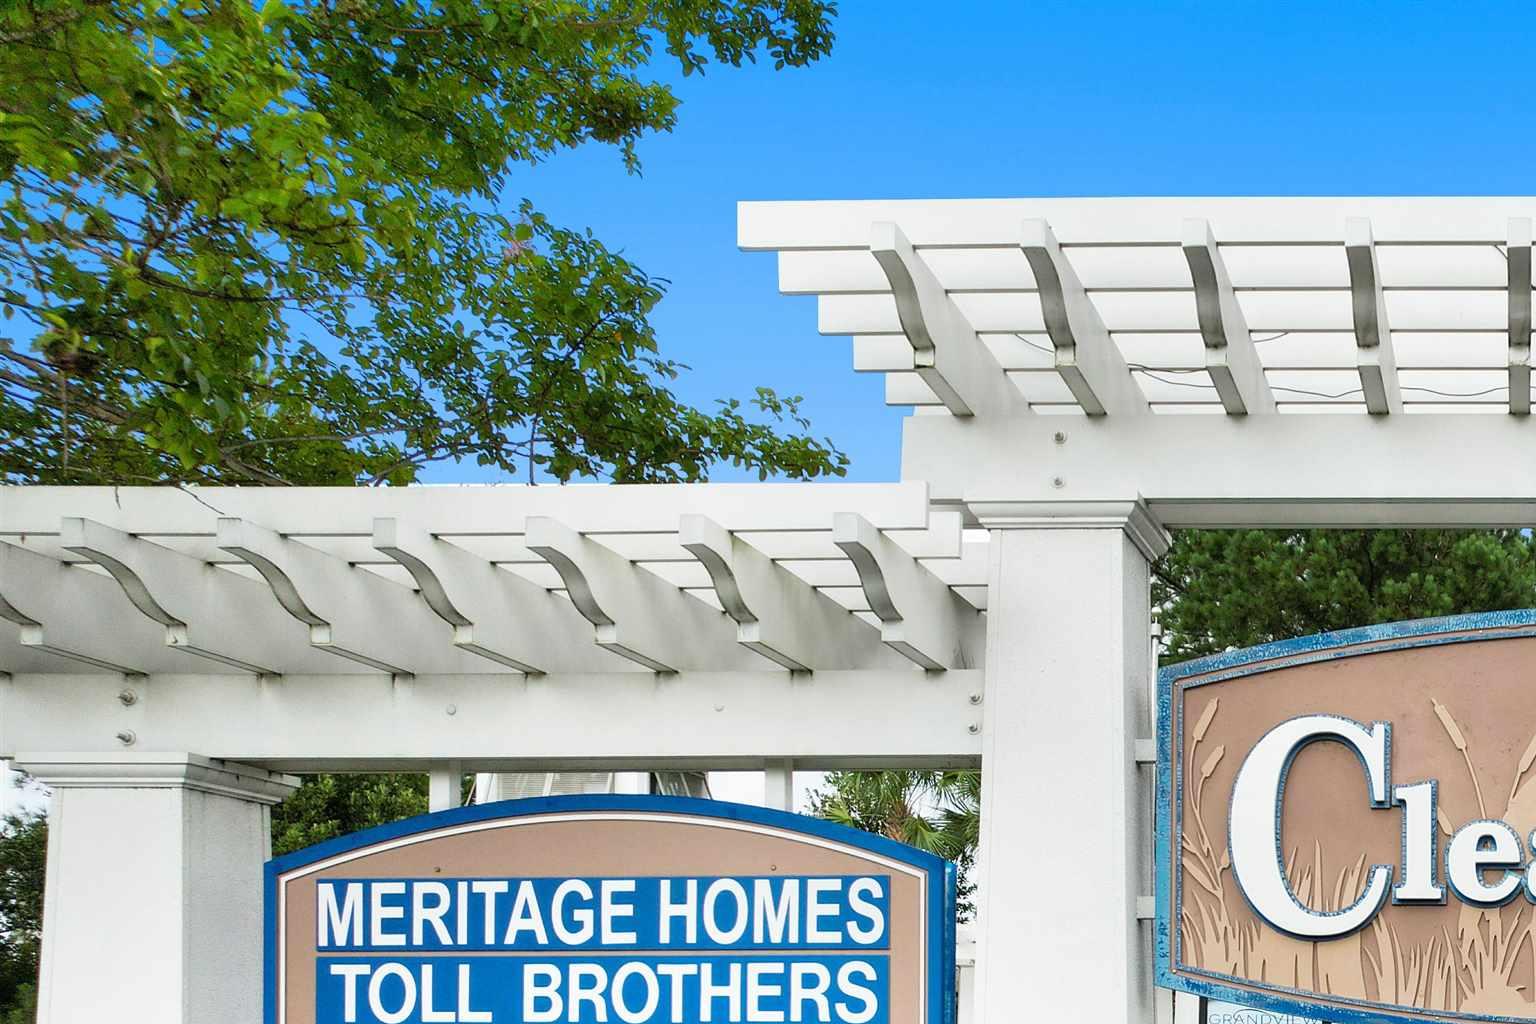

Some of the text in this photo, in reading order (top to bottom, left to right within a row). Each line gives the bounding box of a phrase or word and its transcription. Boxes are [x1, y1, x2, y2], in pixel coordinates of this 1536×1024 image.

[317, 877, 885, 947] MERITAGE HOMES
[330, 960, 880, 1024] TOLL BROTHERS
